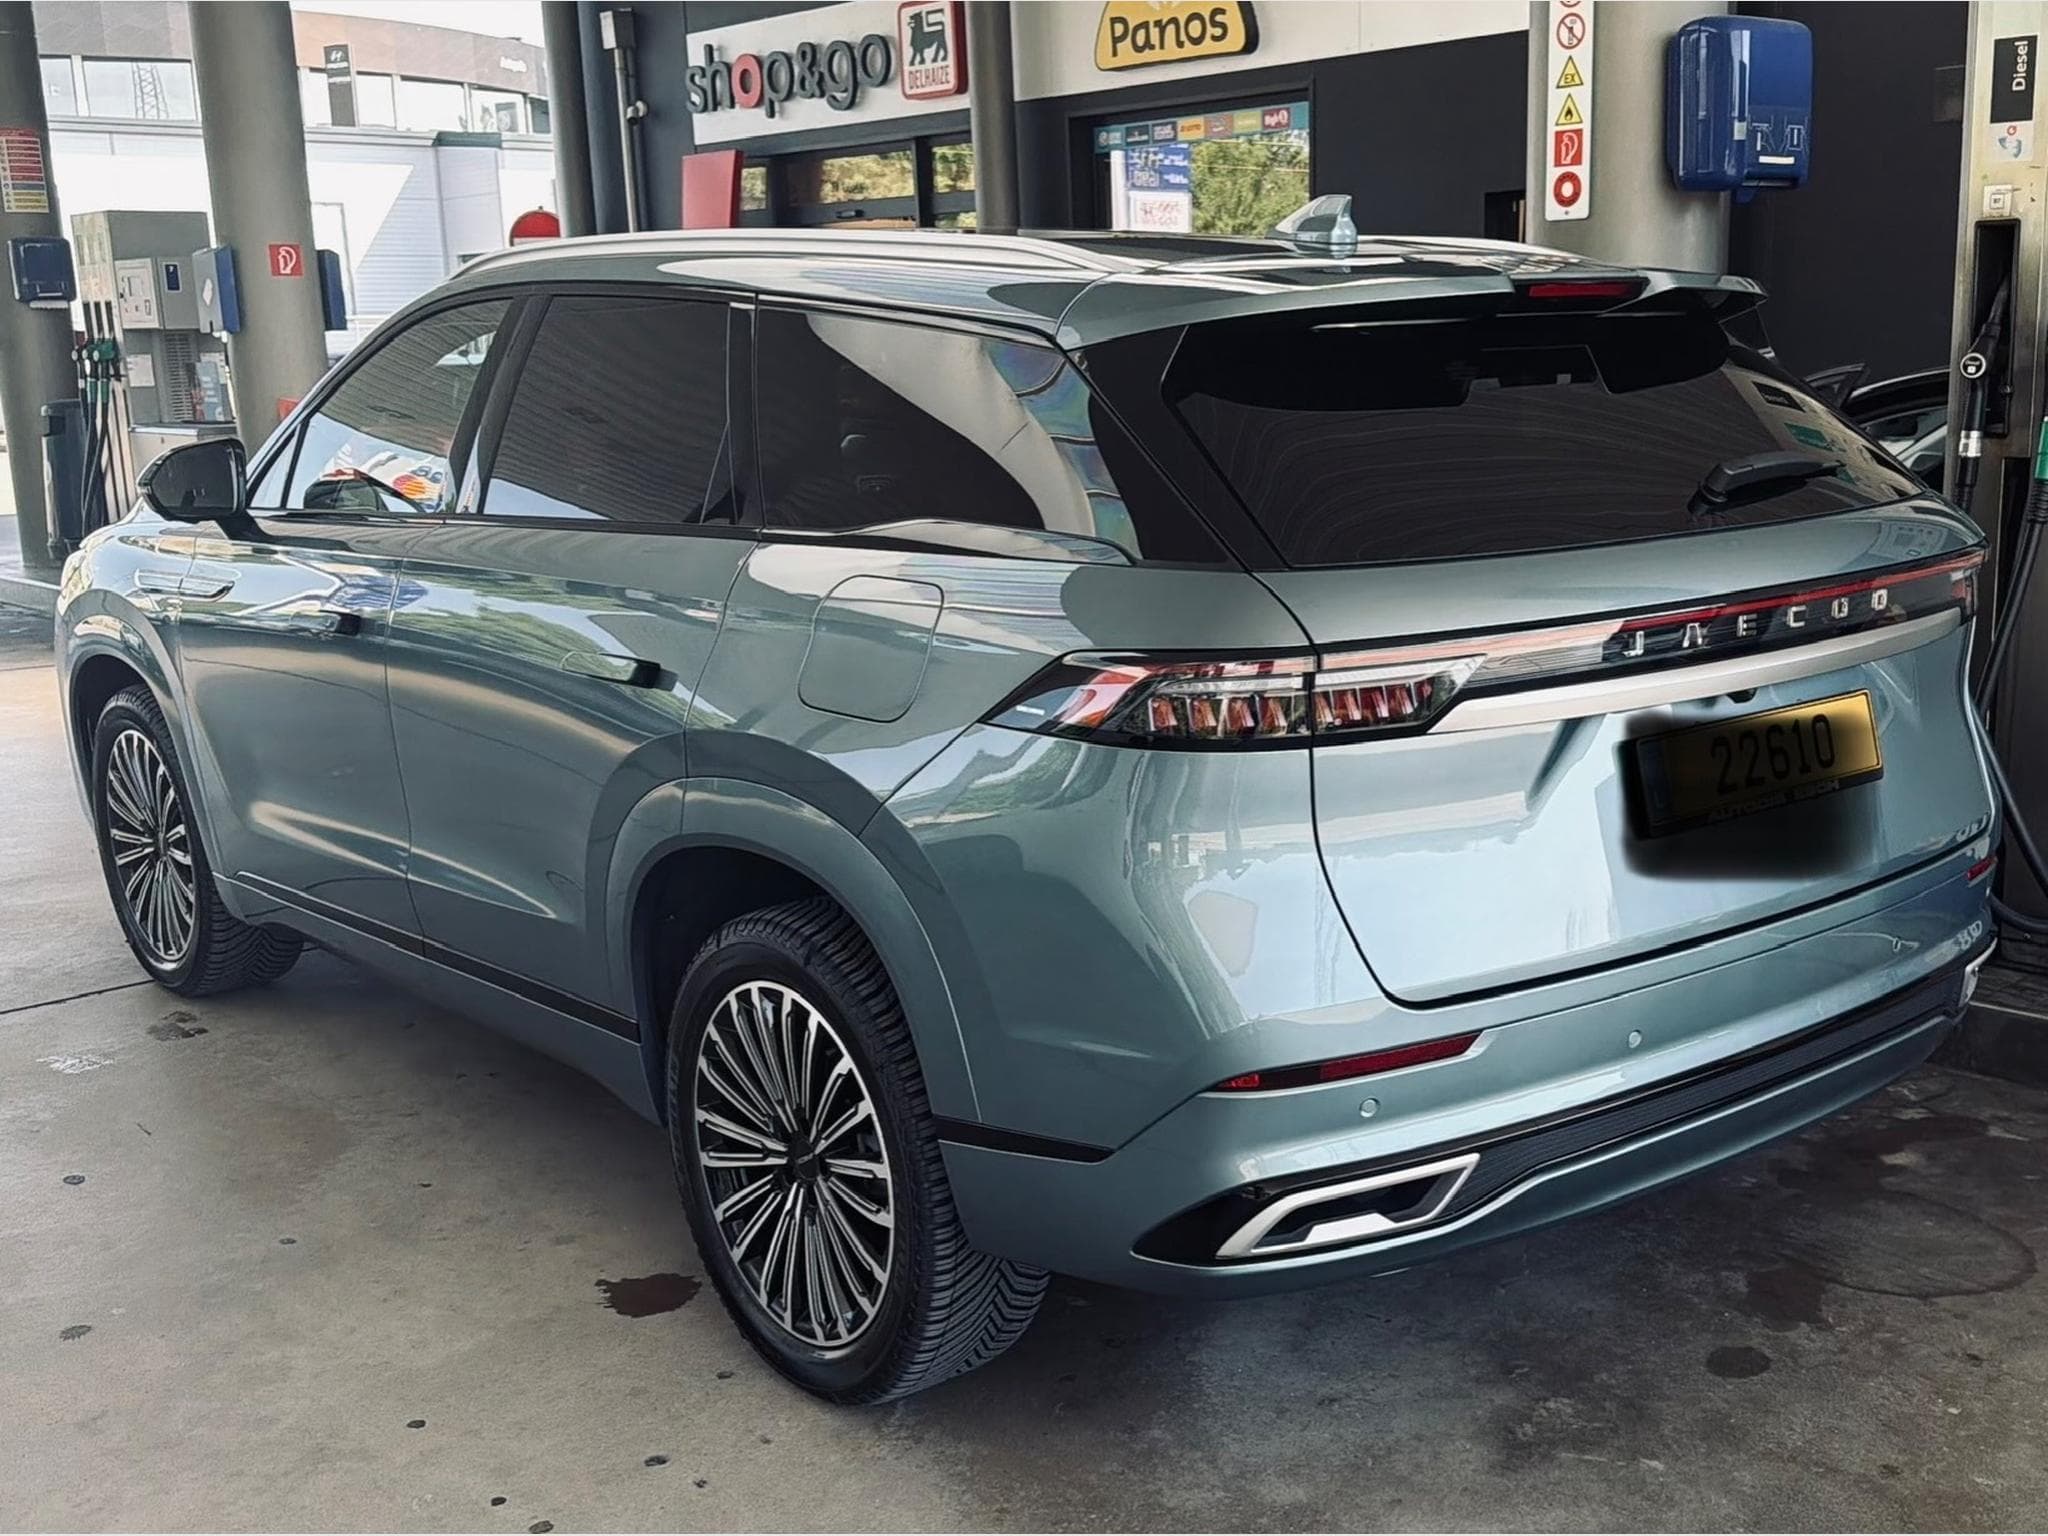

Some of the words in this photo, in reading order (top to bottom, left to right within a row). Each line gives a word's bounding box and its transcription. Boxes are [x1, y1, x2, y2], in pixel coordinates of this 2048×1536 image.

[1109, 7, 1229, 57] Panos
[685, 34, 893, 119] shop&go
[908, 64, 951, 90] DELHAIZE
[1564, 73, 1576, 84] EX
[2012, 41, 2029, 91] Diesel
[1710, 713, 1835, 796] 22610
